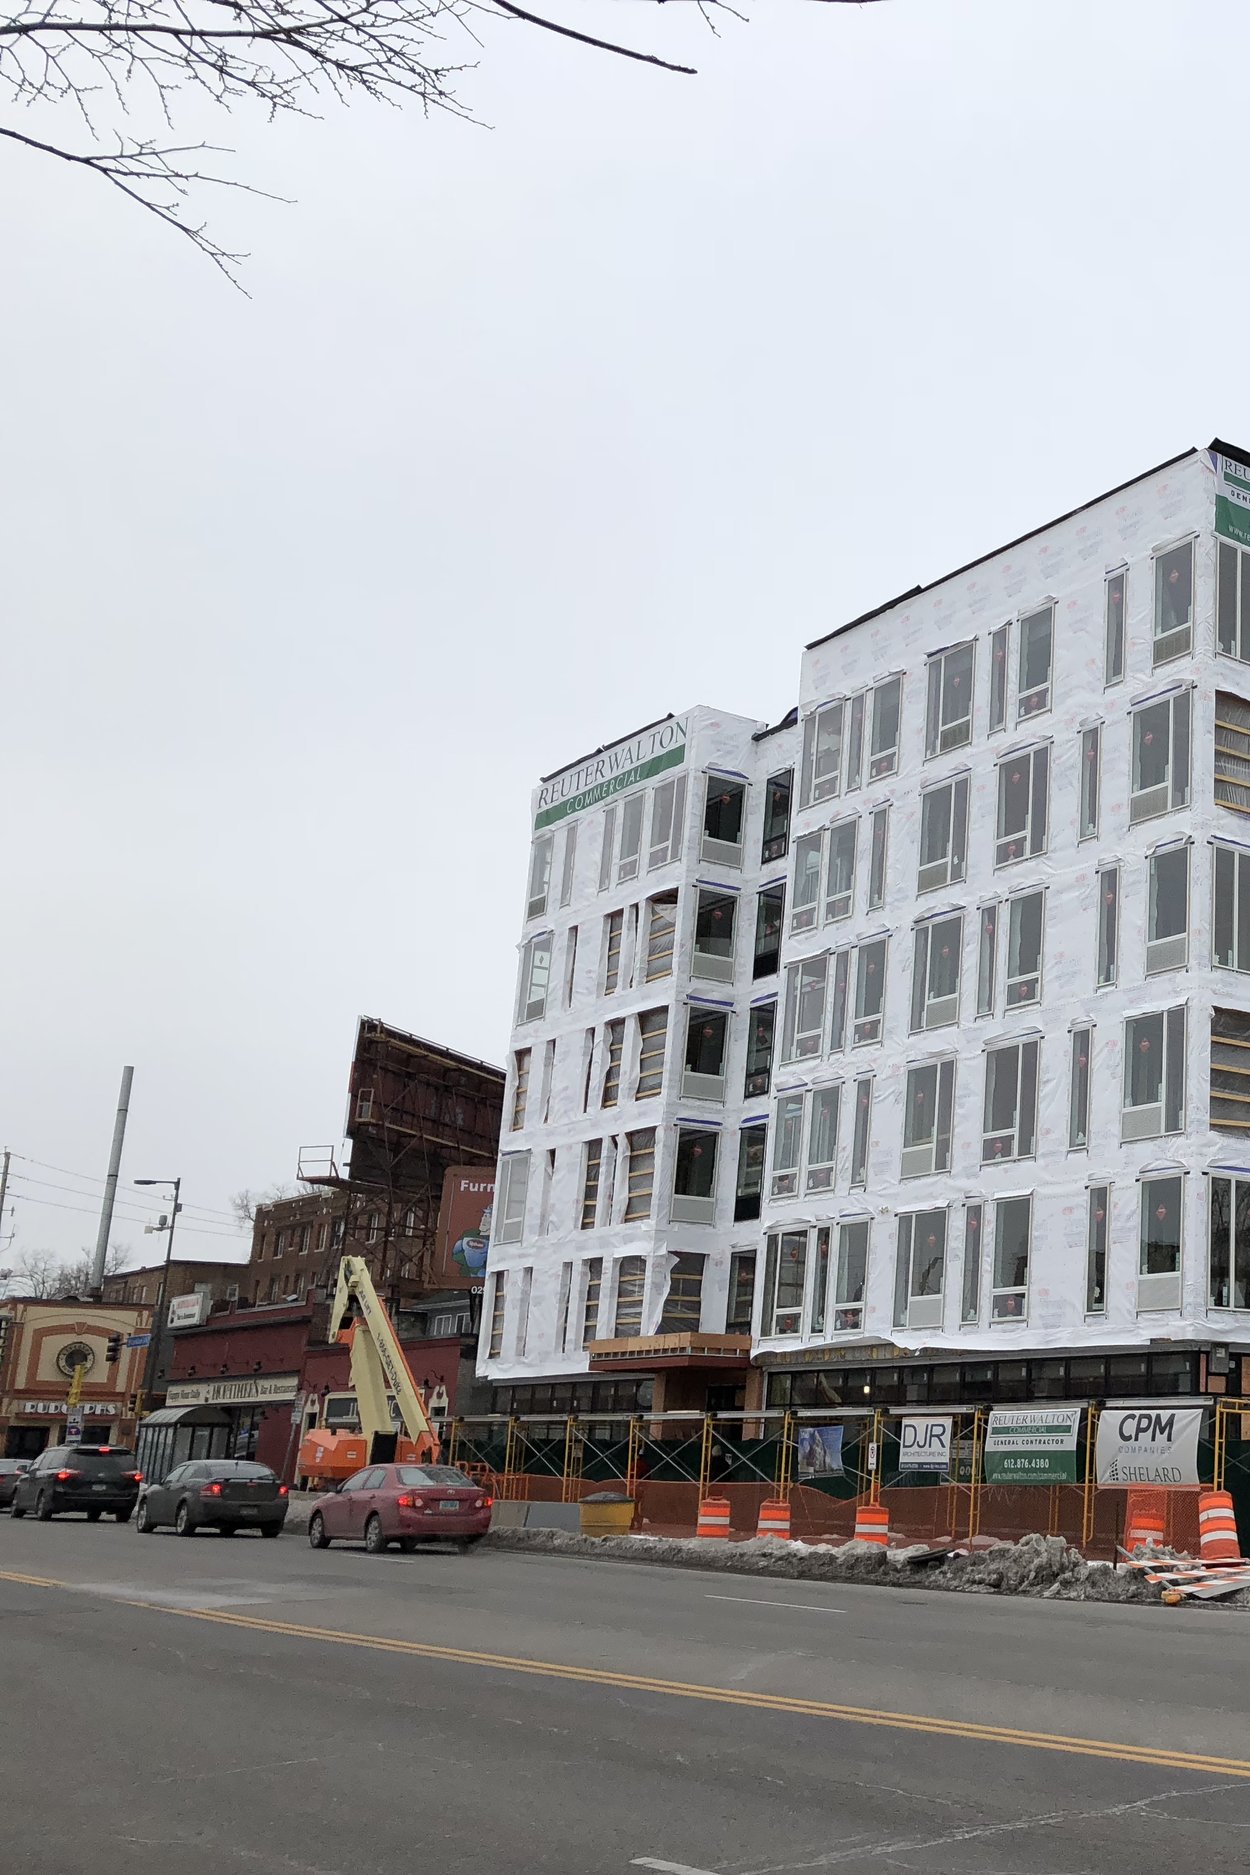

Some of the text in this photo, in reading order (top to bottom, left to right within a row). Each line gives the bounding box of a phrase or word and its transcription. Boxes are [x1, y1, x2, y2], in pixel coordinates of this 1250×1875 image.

[566, 767, 642, 814] COMMERCIAL
[992, 1413, 1074, 1426] REUTERWALTON
[1118, 1413, 1176, 1442] CPM
[902, 1423, 947, 1449] DJR
[1021, 1438, 1065, 1446] CONTRACTOR
[1118, 1445, 1173, 1455] COMPANIES
[1003, 1458, 1050, 1469] 612.876.4380
[1121, 1465, 1182, 1483] SHELARD
